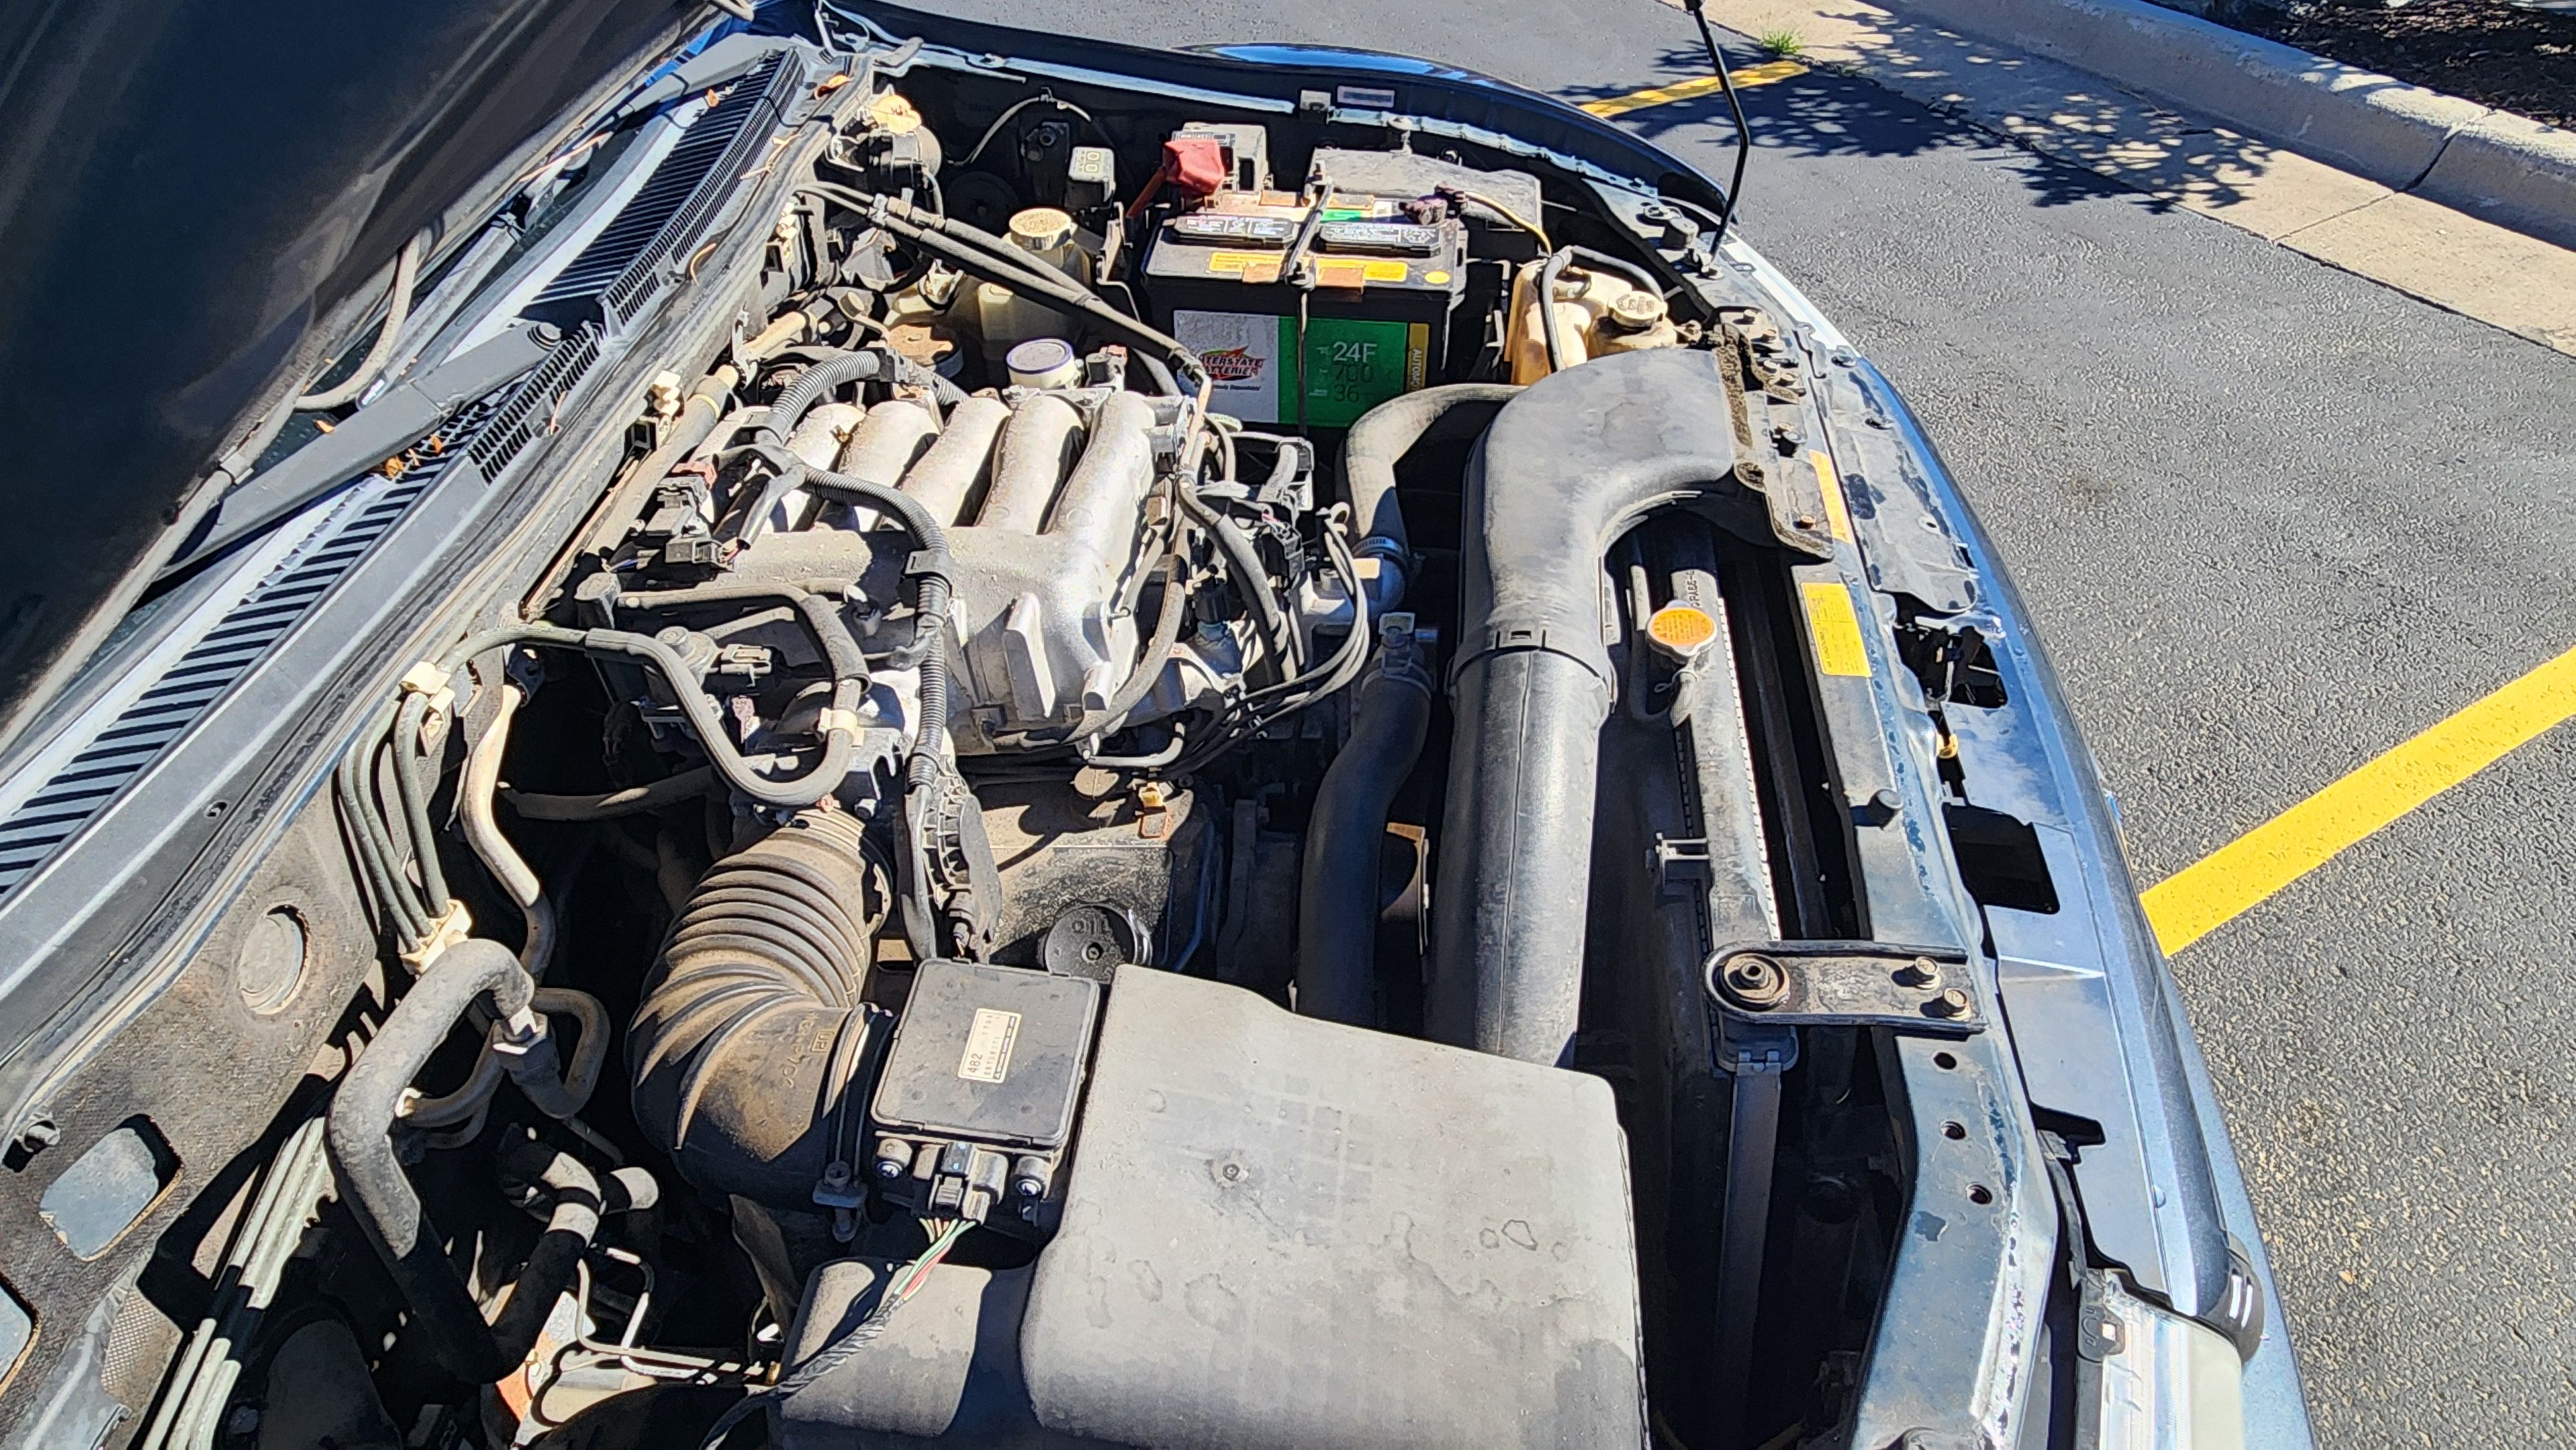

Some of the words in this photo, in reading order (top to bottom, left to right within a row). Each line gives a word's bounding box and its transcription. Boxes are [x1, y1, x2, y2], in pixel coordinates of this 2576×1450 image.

[1198, 354, 1263, 366] NTERSTATE
[1332, 341, 1378, 362] 24F
[1205, 366, 1260, 376] ATTERIES
[1332, 362, 1374, 383] 700
[1410, 348, 1423, 391] AUTOMO
[1332, 384, 1359, 402] 36
[1071, 919, 1113, 935] OIL
[967, 1053, 983, 1073] 482
